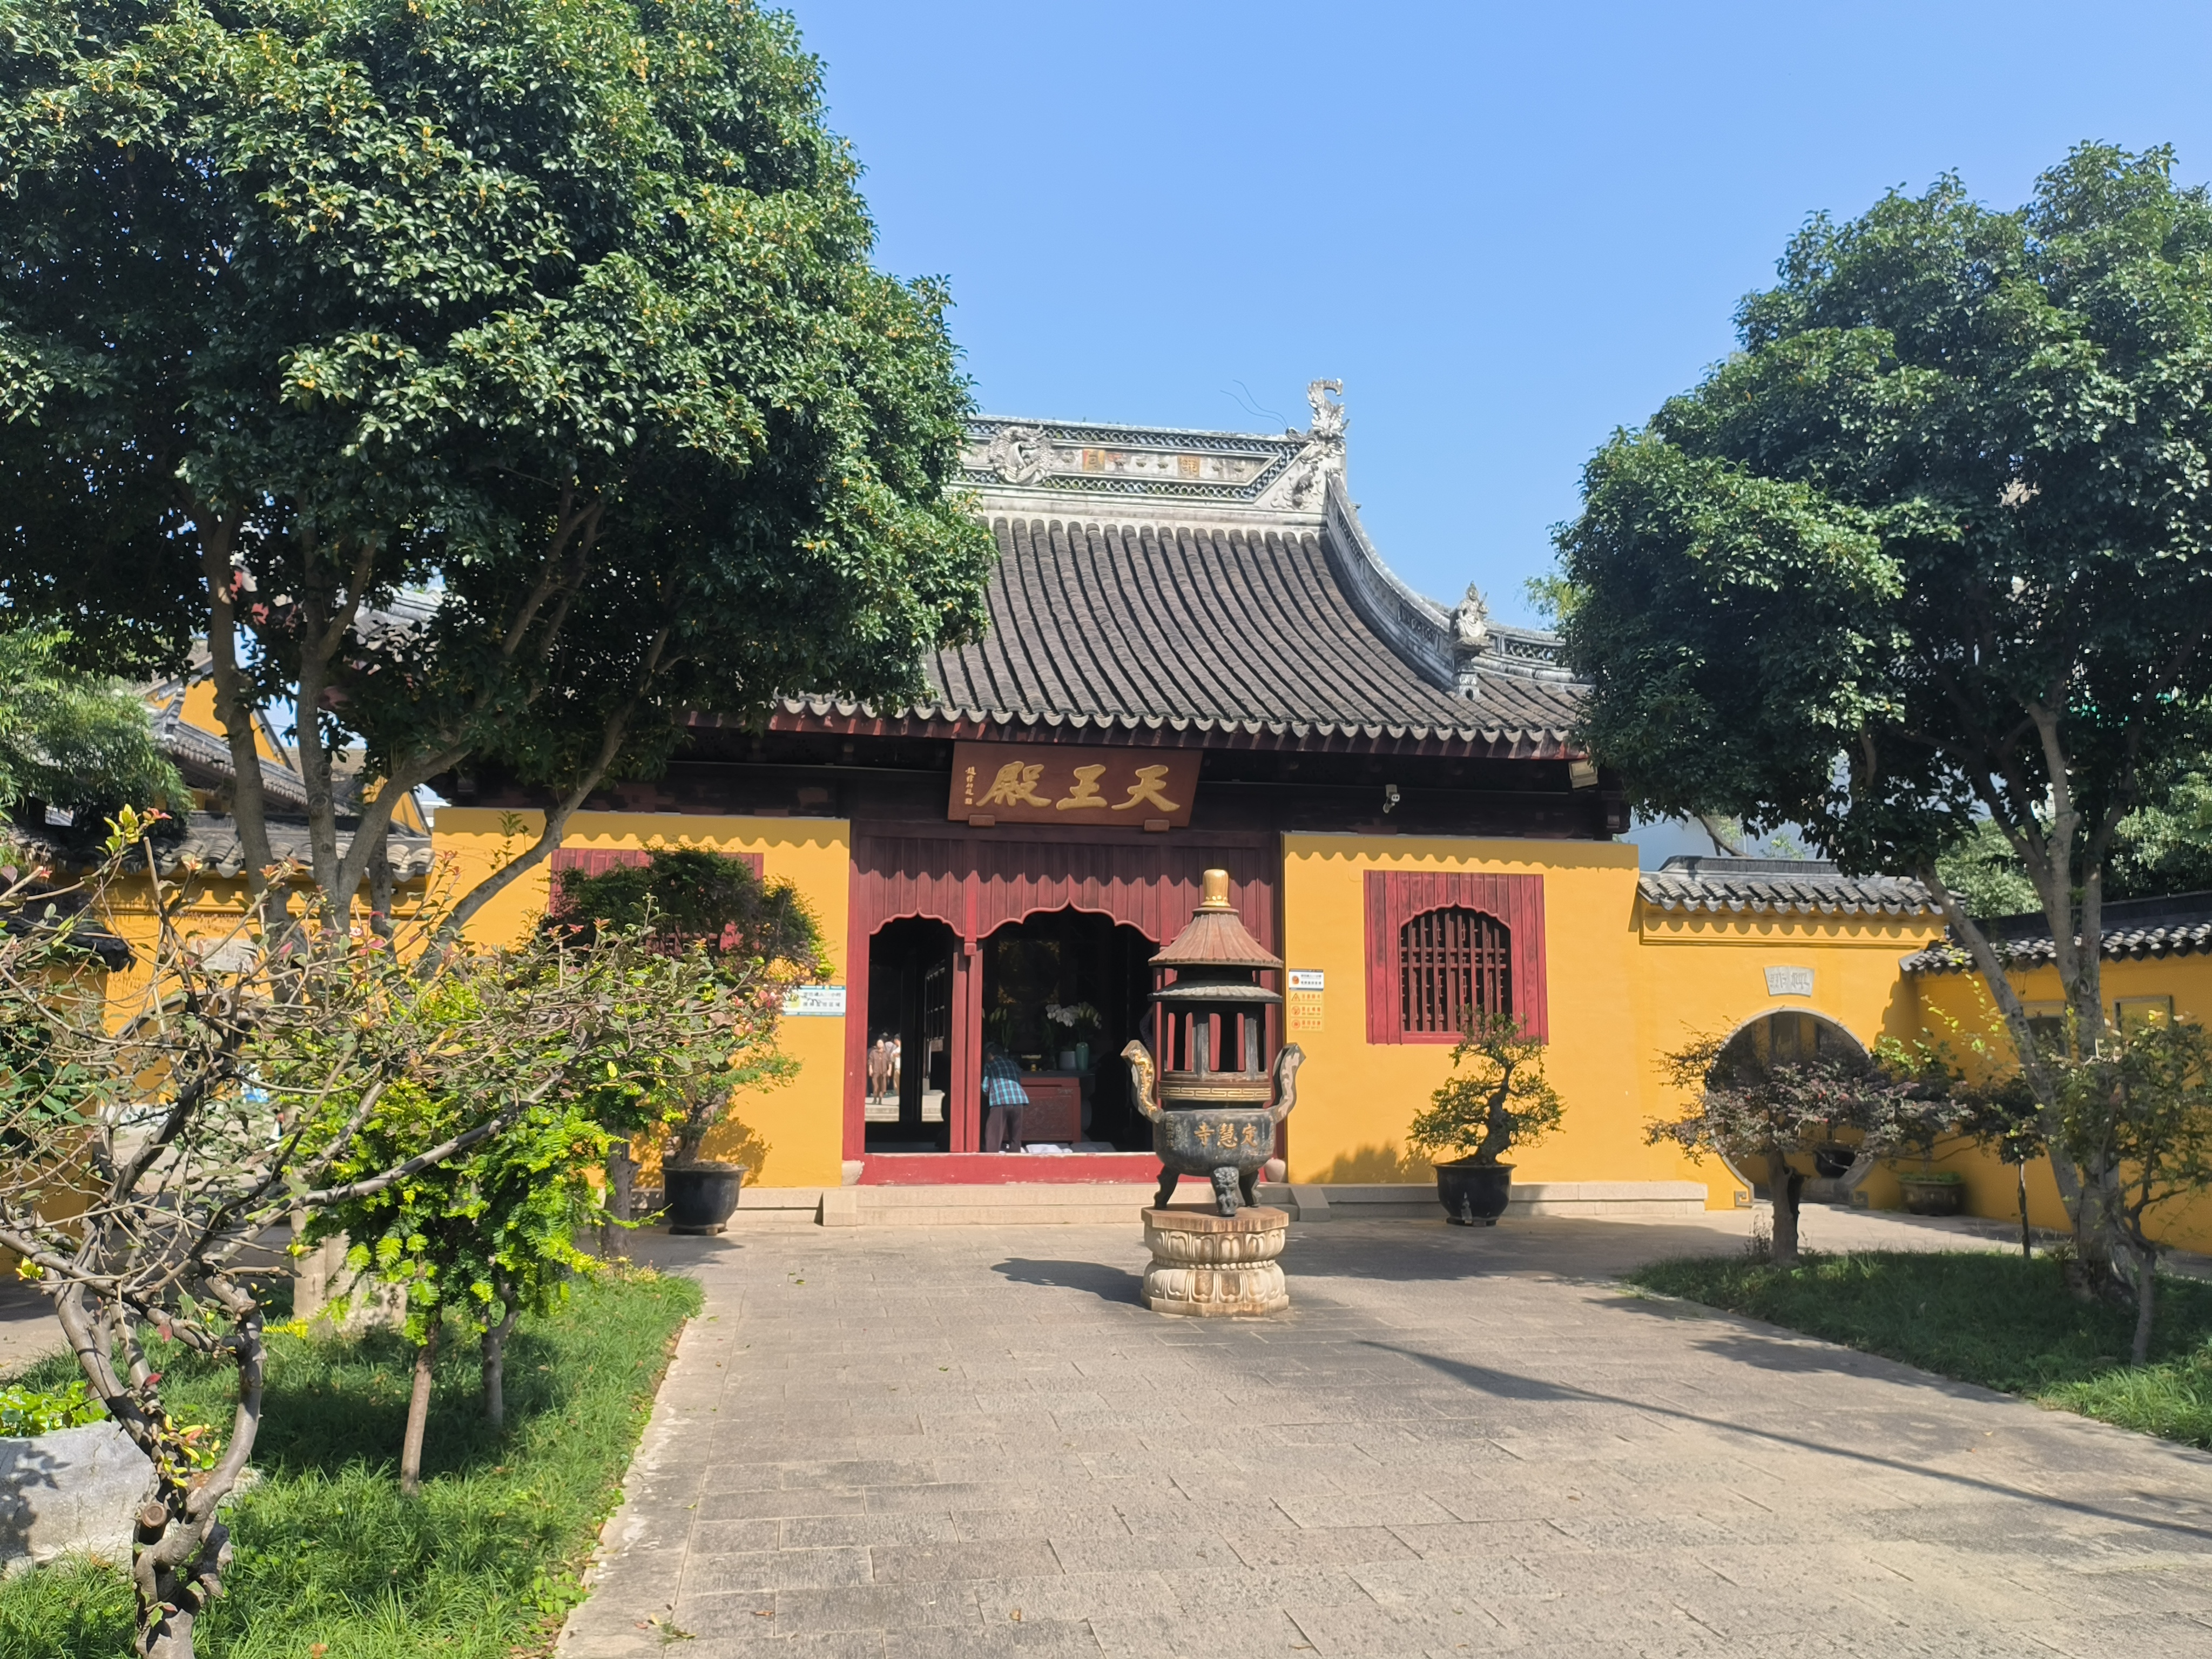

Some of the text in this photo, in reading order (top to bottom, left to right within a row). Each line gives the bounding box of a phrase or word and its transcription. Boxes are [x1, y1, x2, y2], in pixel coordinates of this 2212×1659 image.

[975, 760, 1181, 812] 天王殿
[1193, 1122, 1258, 1149] 定慧寺
